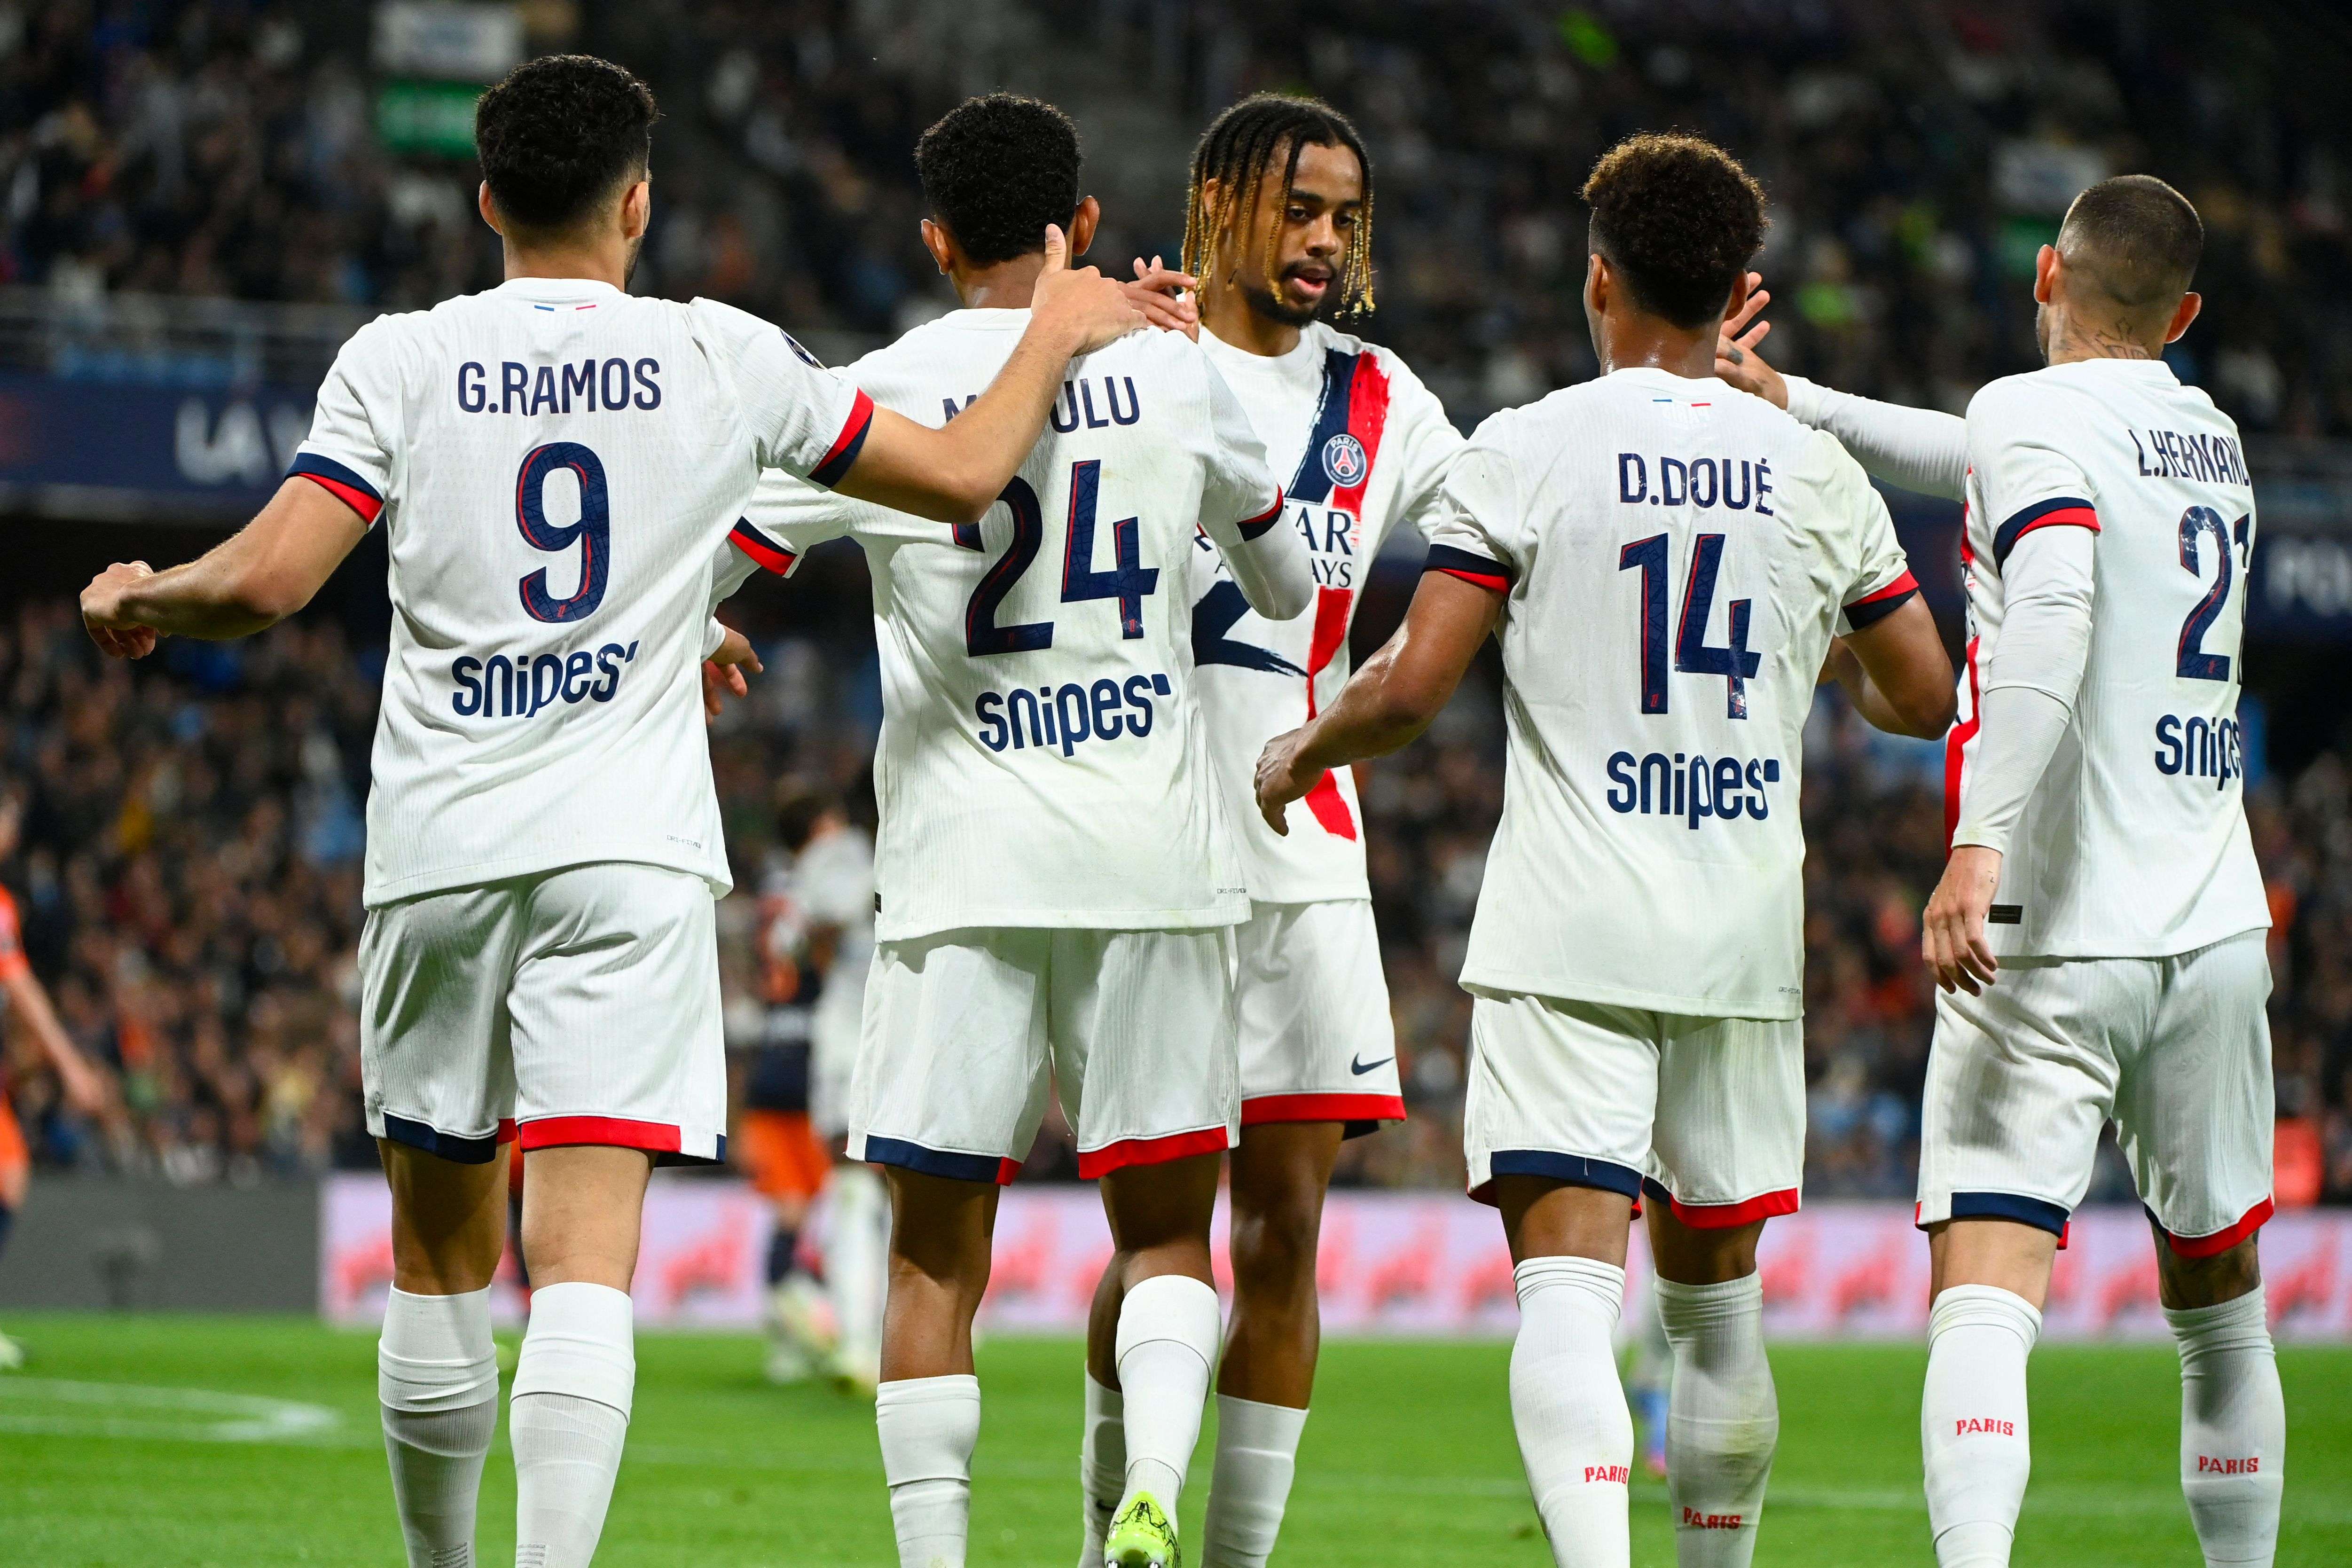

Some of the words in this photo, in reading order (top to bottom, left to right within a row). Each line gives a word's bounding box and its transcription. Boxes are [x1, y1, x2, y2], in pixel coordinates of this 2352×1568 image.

[458, 358, 661, 416] G.RAMOS
[942, 376, 1140, 433] MULU
[1329, 437, 1359, 453] PARIS
[1618, 453, 1774, 517] D.DOUÉ
[516, 442, 610, 623] 9
[951, 459, 1160, 657] 24
[1618, 533, 1761, 720] 14
[1956, 1418, 2014, 1436] PARIS
[1584, 1465, 1630, 1485] PARIS
[2198, 1455, 2260, 1474] PARIS
[1683, 1506, 1742, 1529] PARIS
